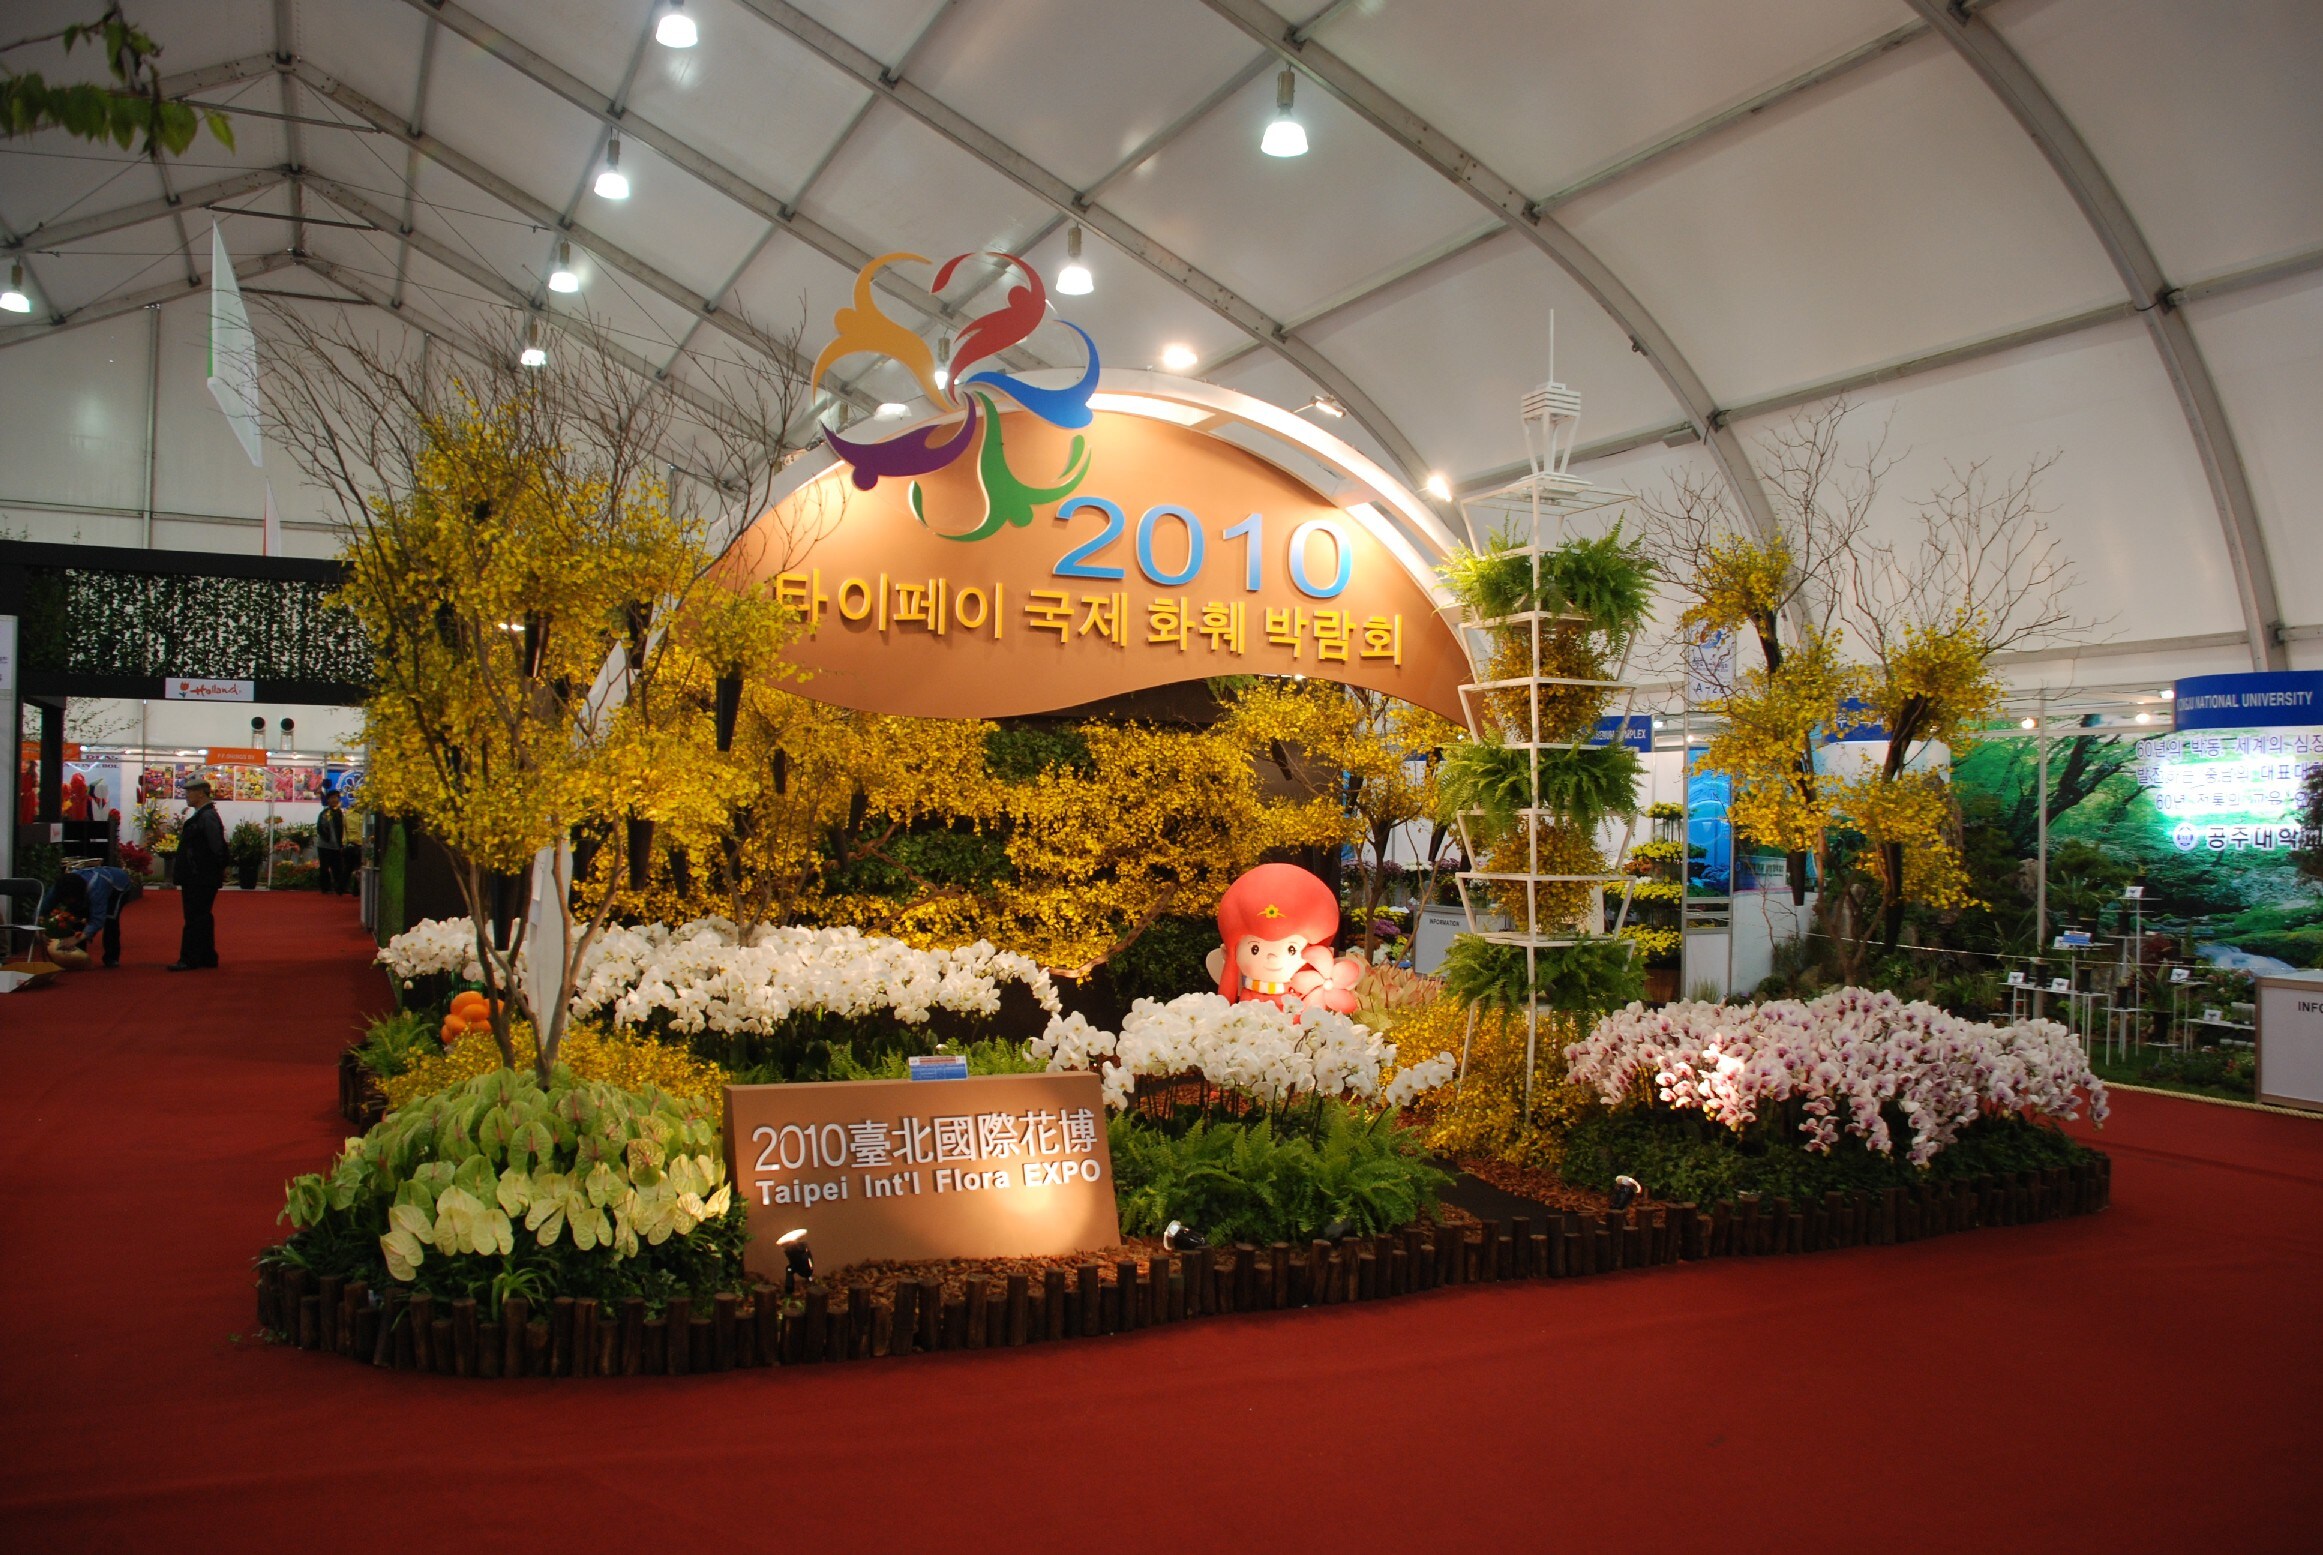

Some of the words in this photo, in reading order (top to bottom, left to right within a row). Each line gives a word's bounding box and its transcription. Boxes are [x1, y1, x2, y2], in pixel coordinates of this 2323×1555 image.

[1052, 495, 1353, 599] 2010
[776, 568, 1003, 639] 타이페이
[1025, 589, 1128, 647] 국제
[1147, 596, 1245, 655] 화훼
[1265, 606, 1402, 665] 박람회
[2195, 694, 2239, 709] NATIONAL
[2242, 692, 2313, 707] UNIVERSITY
[2136, 740, 2181, 758] 60년의
[2235, 735, 2283, 755] 세계의
[1429, 919, 1459, 927] INFORMATION
[752, 1109, 1098, 1171] 2010臺北國際花博
[755, 1176, 848, 1207] Taipei
[864, 1169, 921, 1198] Int'l
[937, 1168, 1010, 1193] Flora
[1023, 1158, 1101, 1187] EXPO
